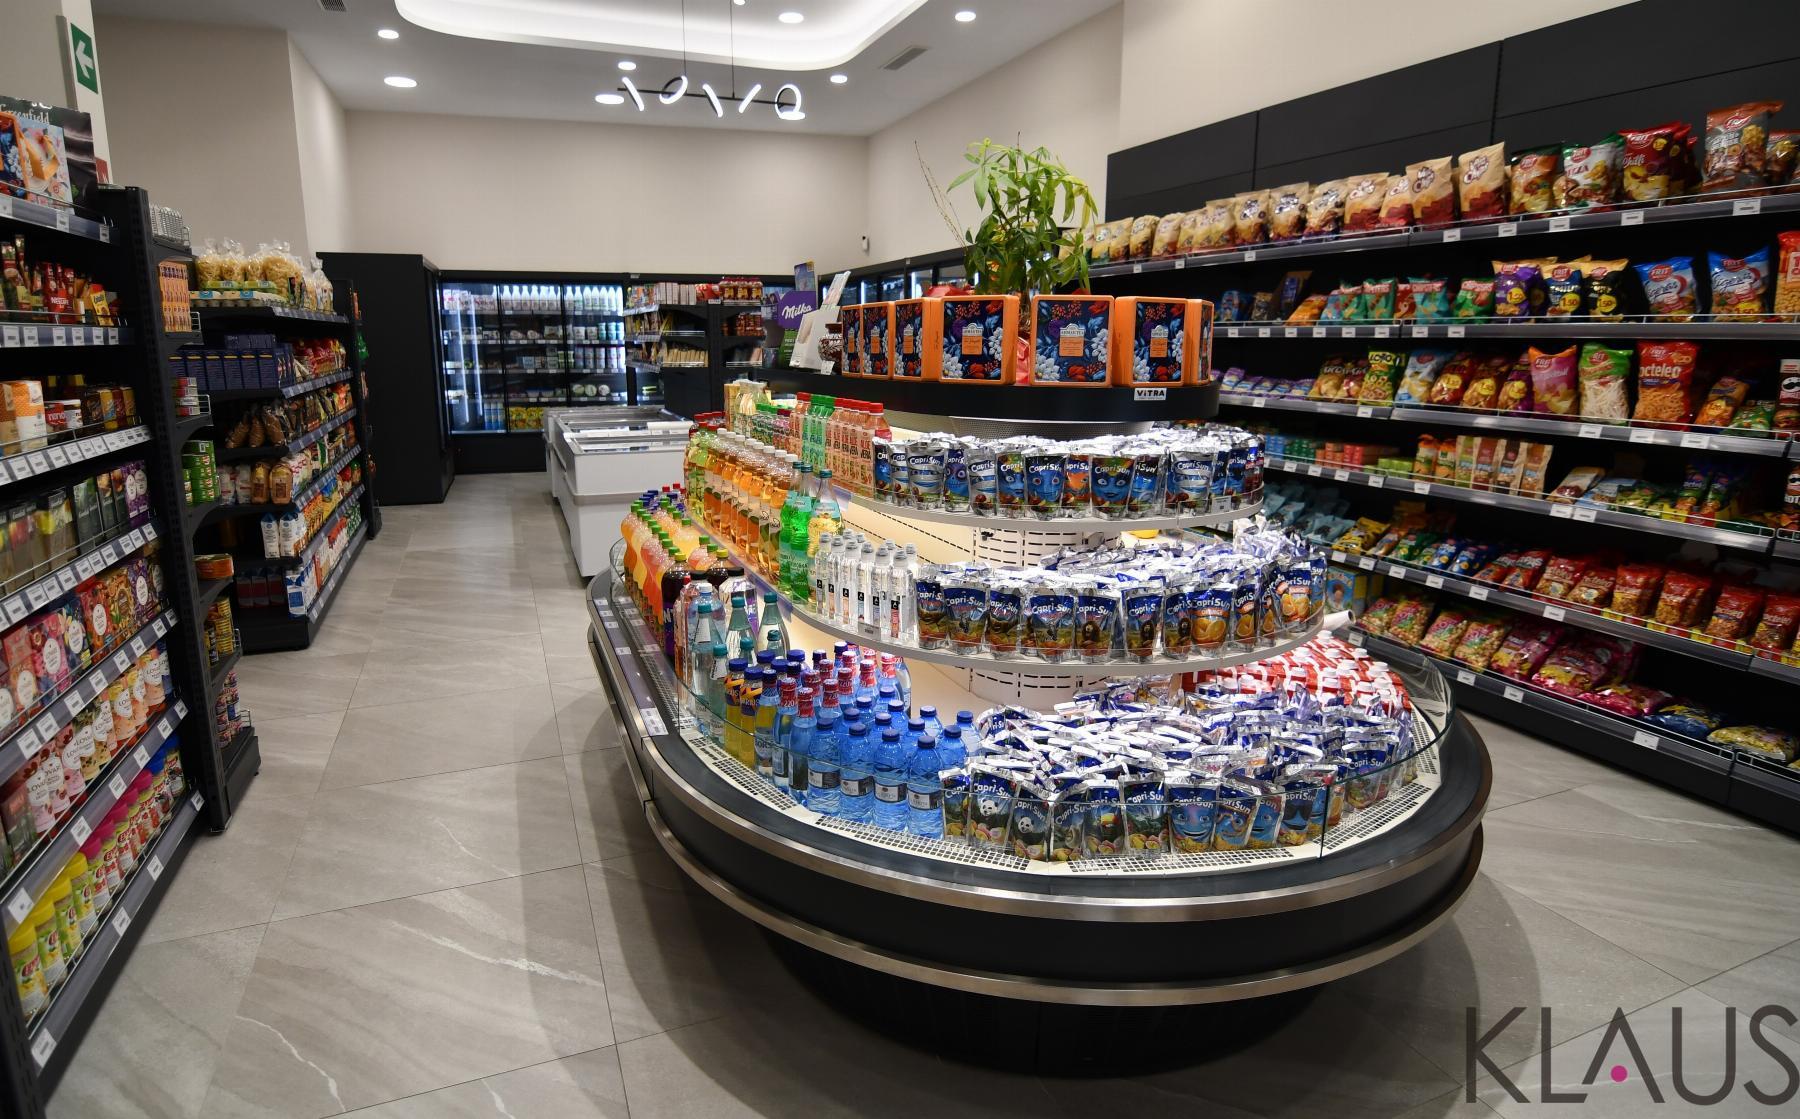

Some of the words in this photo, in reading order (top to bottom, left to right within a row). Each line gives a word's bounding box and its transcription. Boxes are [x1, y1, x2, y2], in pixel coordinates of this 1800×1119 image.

[781, 303, 812, 320] Milka
[1640, 363, 1681, 379] octeleo
[971, 460, 995, 472] CapriS
[1029, 463, 1062, 474] CapriSun
[1094, 465, 1131, 475] CapriSun
[1135, 462, 1158, 474] riSun
[917, 589, 943, 600] Capri-S
[1234, 592, 1254, 607] CapriS
[990, 601, 1019, 615] apri-Sun
[1032, 602, 1072, 614] Capri-Sun
[1129, 603, 1156, 617] Capri-S
[1014, 801, 1046, 822] apri-Sun
[1220, 798, 1251, 814] priSun
[1055, 804, 1087, 825] Capri-Su
